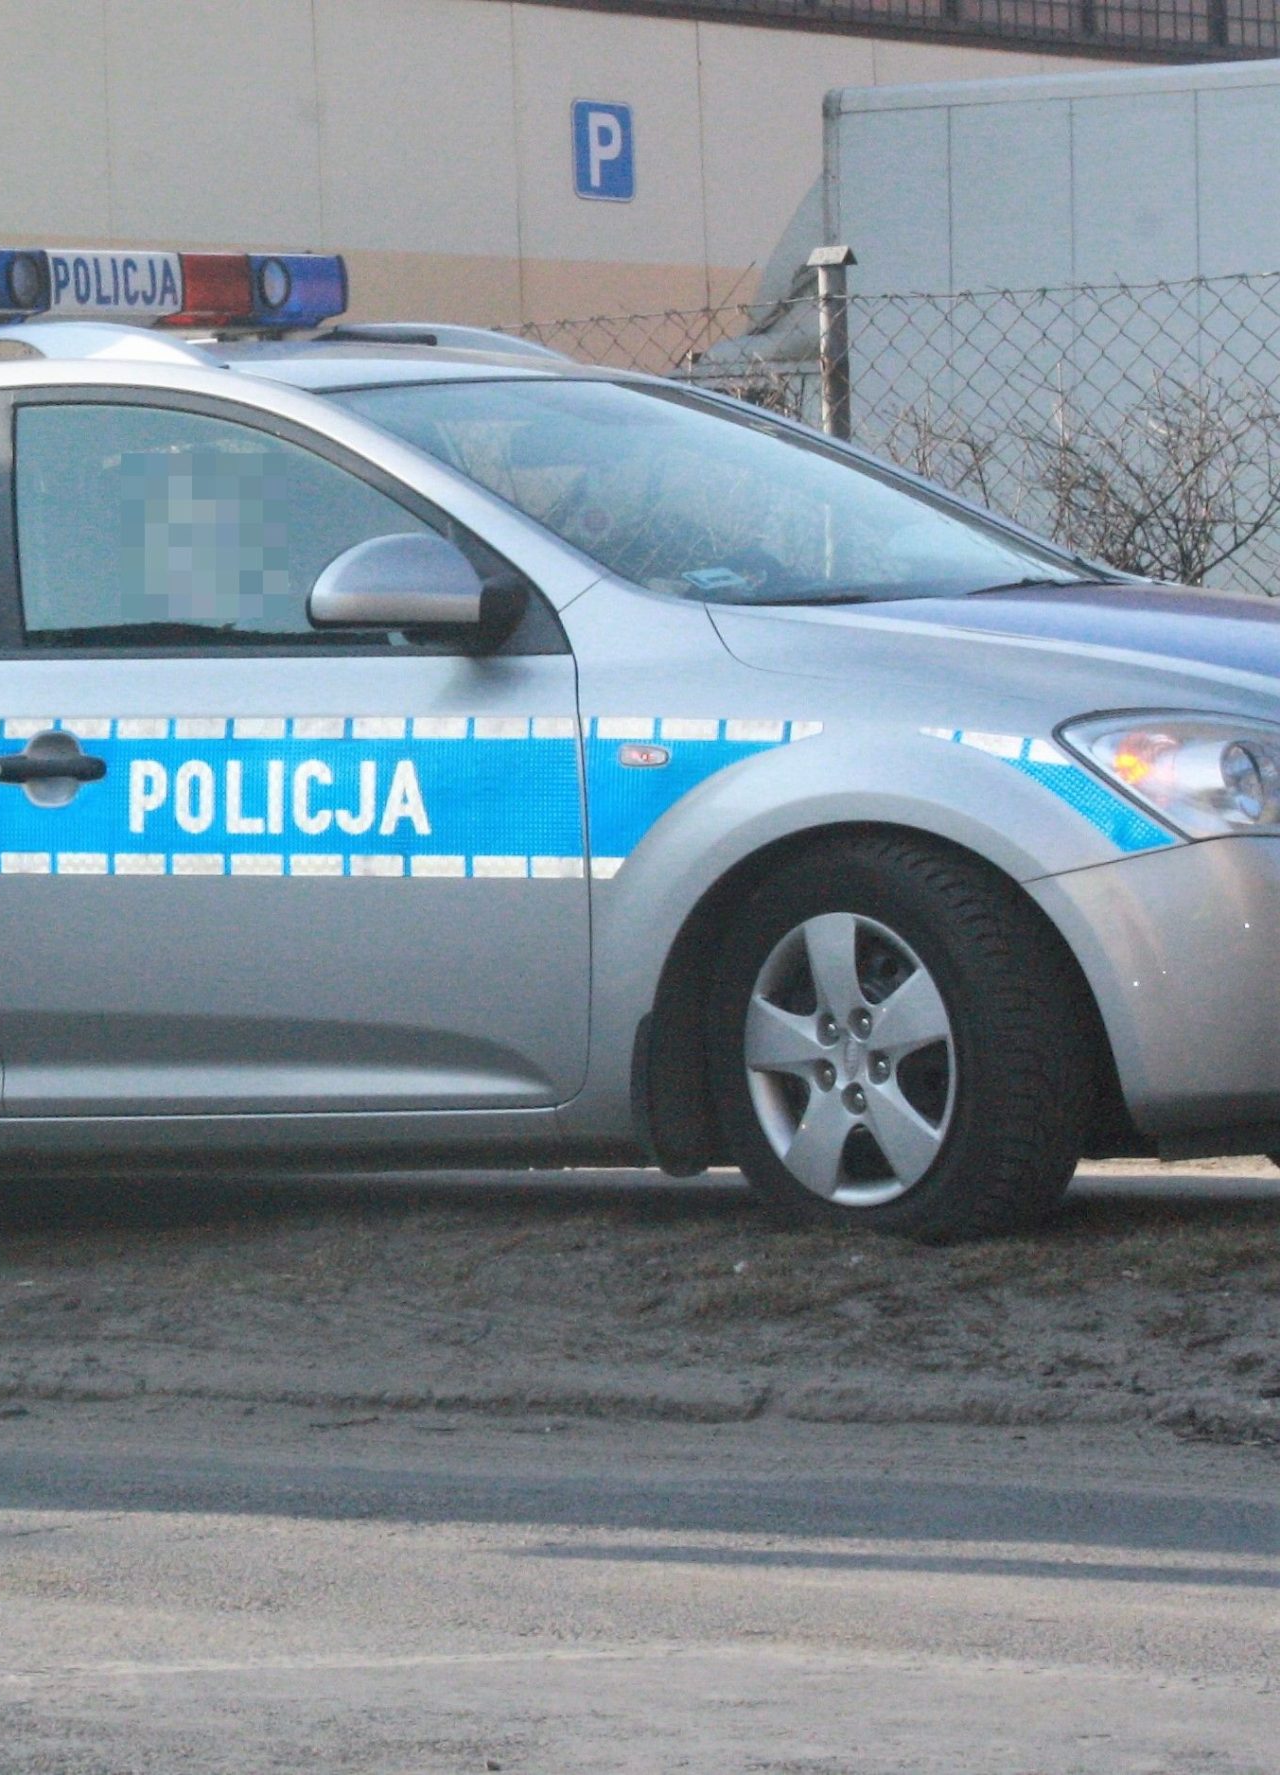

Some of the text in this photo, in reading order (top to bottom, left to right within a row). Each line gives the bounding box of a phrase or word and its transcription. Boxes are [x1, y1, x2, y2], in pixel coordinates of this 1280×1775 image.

[588, 111, 622, 188] P
[51, 256, 179, 306] POLICJA
[128, 759, 432, 836] POLICJA
